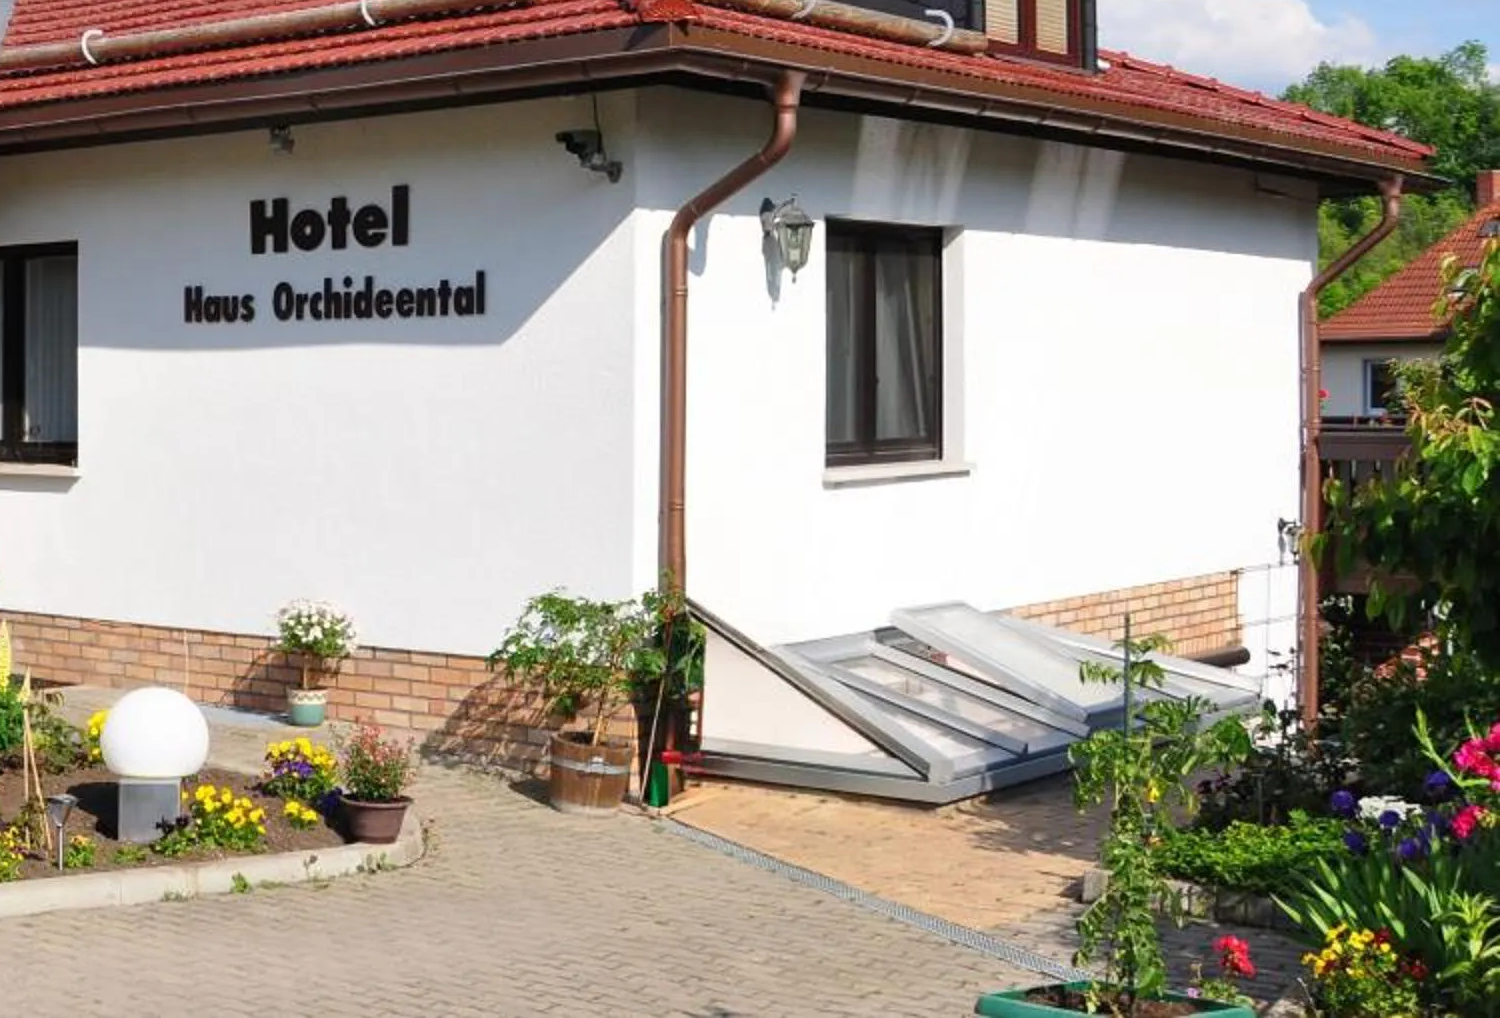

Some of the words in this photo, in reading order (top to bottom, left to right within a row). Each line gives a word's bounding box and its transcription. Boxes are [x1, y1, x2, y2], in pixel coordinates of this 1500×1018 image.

[249, 183, 411, 255] Hotel
[184, 285, 255, 324] Haus
[272, 269, 487, 322] Orchideental
